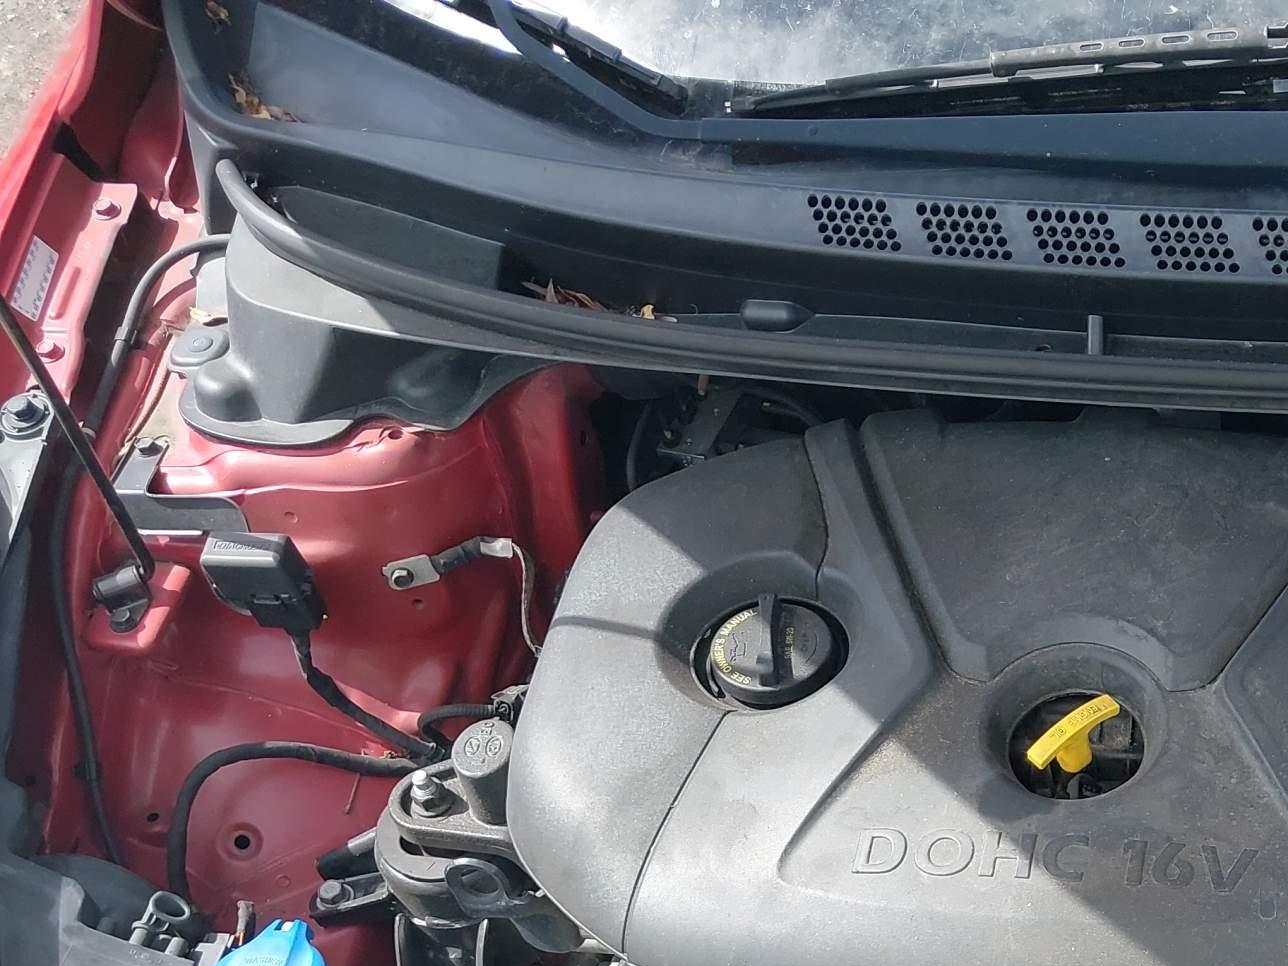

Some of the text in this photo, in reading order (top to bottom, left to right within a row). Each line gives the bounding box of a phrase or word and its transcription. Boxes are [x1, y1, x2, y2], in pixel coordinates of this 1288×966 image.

[713, 609, 759, 685] SEE OWNER'S MANUAL
[851, 826, 1259, 895] DOHC 16V
